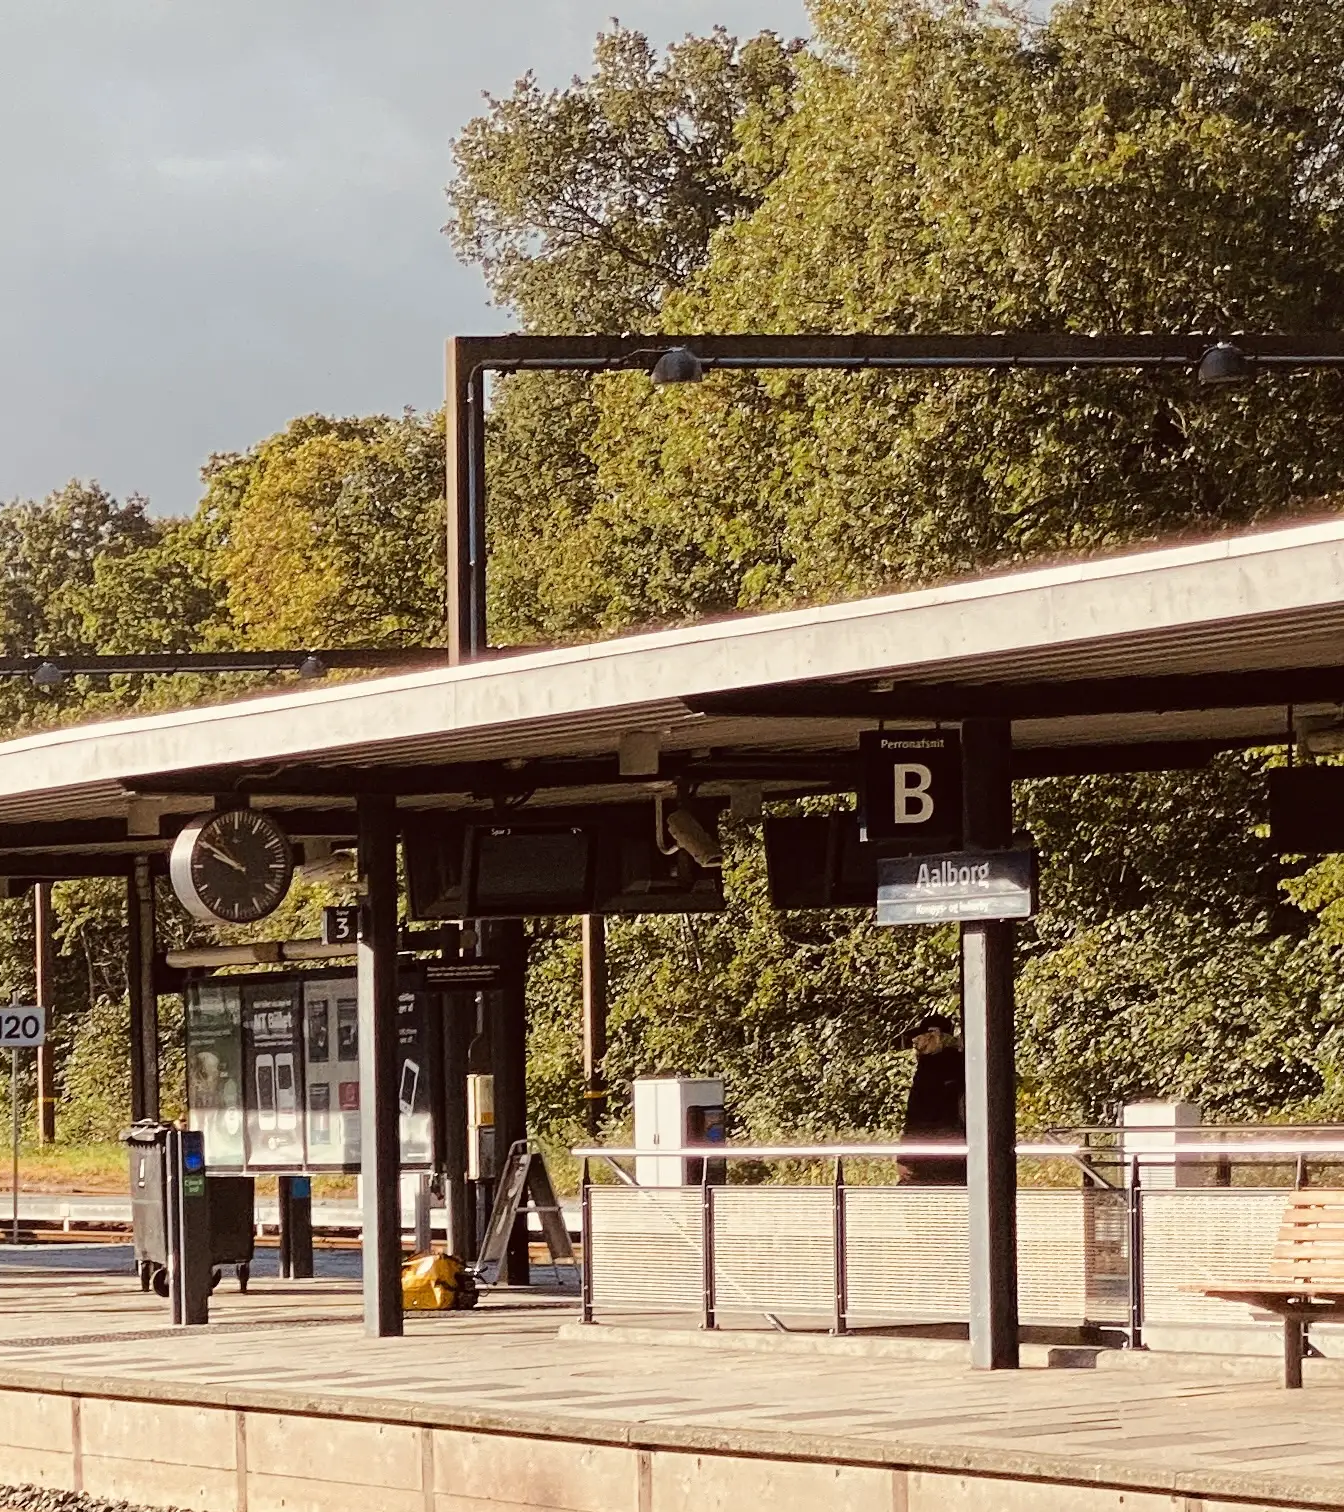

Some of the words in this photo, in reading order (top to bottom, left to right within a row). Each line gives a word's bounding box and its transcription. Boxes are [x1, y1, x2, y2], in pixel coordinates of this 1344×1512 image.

[880, 739, 945, 750] Perronafsnit
[894, 763, 934, 824] B
[916, 860, 990, 889] Aalborg
[336, 917, 349, 939] 3
